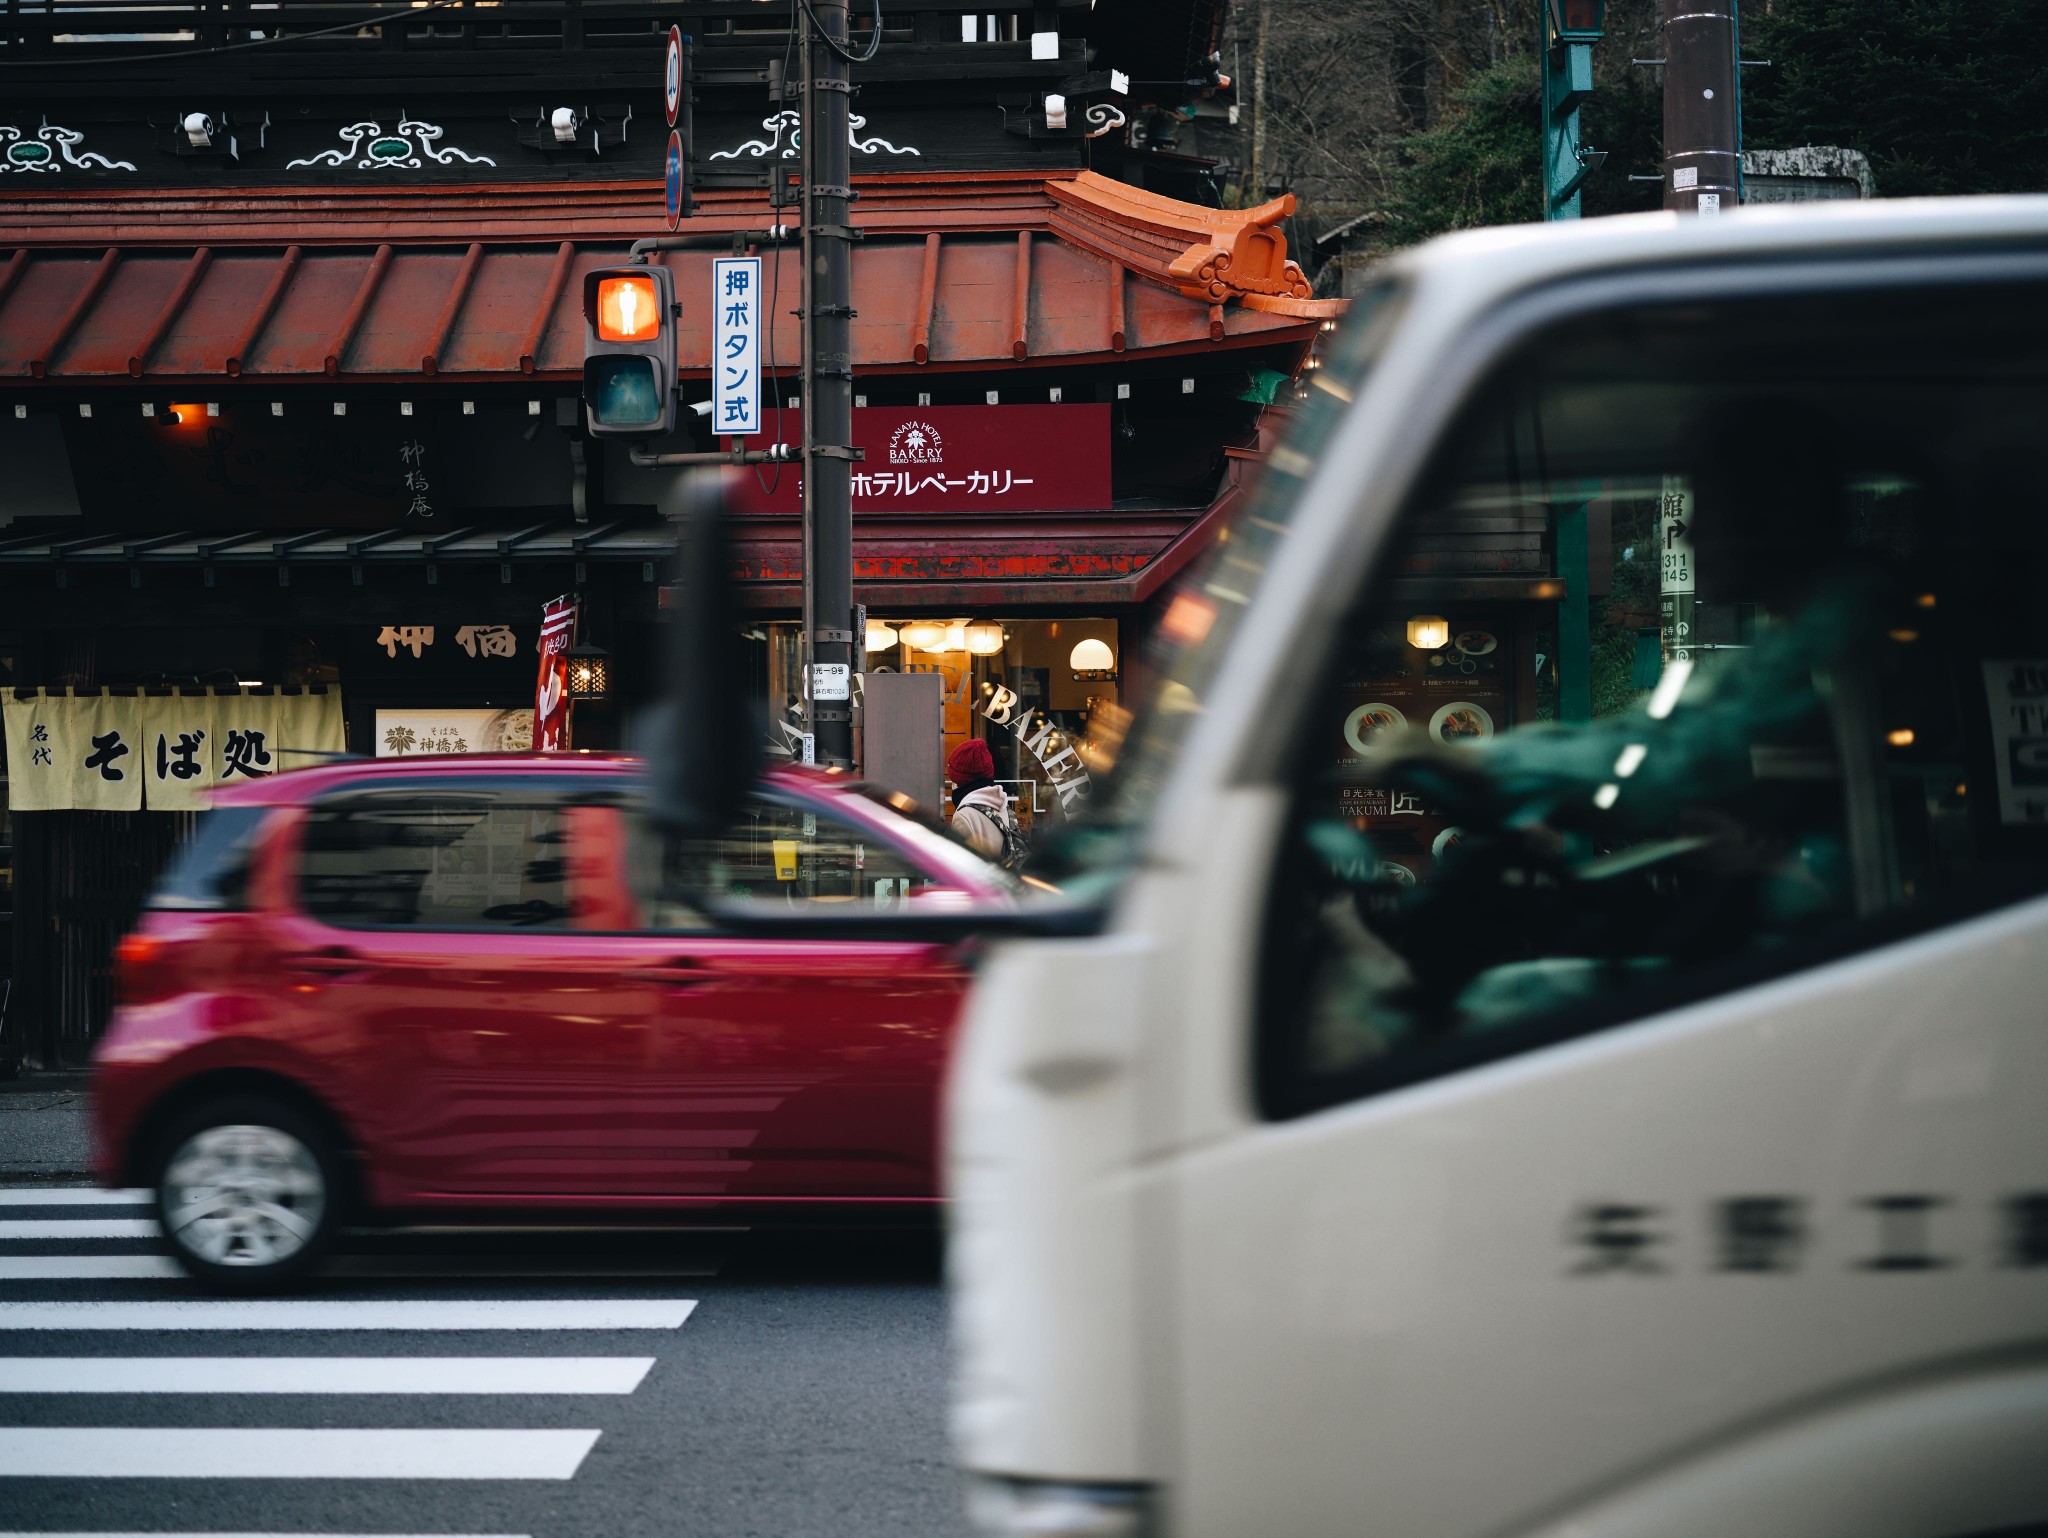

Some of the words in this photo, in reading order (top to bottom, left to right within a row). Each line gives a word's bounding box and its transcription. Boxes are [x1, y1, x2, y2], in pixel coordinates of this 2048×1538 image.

[725, 270, 749, 422] 押ボタン式
[889, 420, 919, 448] KANAYA
[920, 422, 942, 448] HOTEL
[889, 447, 942, 459] BAKERY
[399, 439, 434, 517] 神橋庵
[30, 723, 53, 767] 名代
[419, 738, 469, 753] 神橋庵
[430, 727, 459, 736] そば処
[84, 729, 273, 781] そば処
[981, 683, 1093, 823] BAKER
[1343, 788, 1386, 798] 日光洋食
[1390, 787, 1425, 816] 匠
[1339, 805, 1388, 816] TAKUMI
